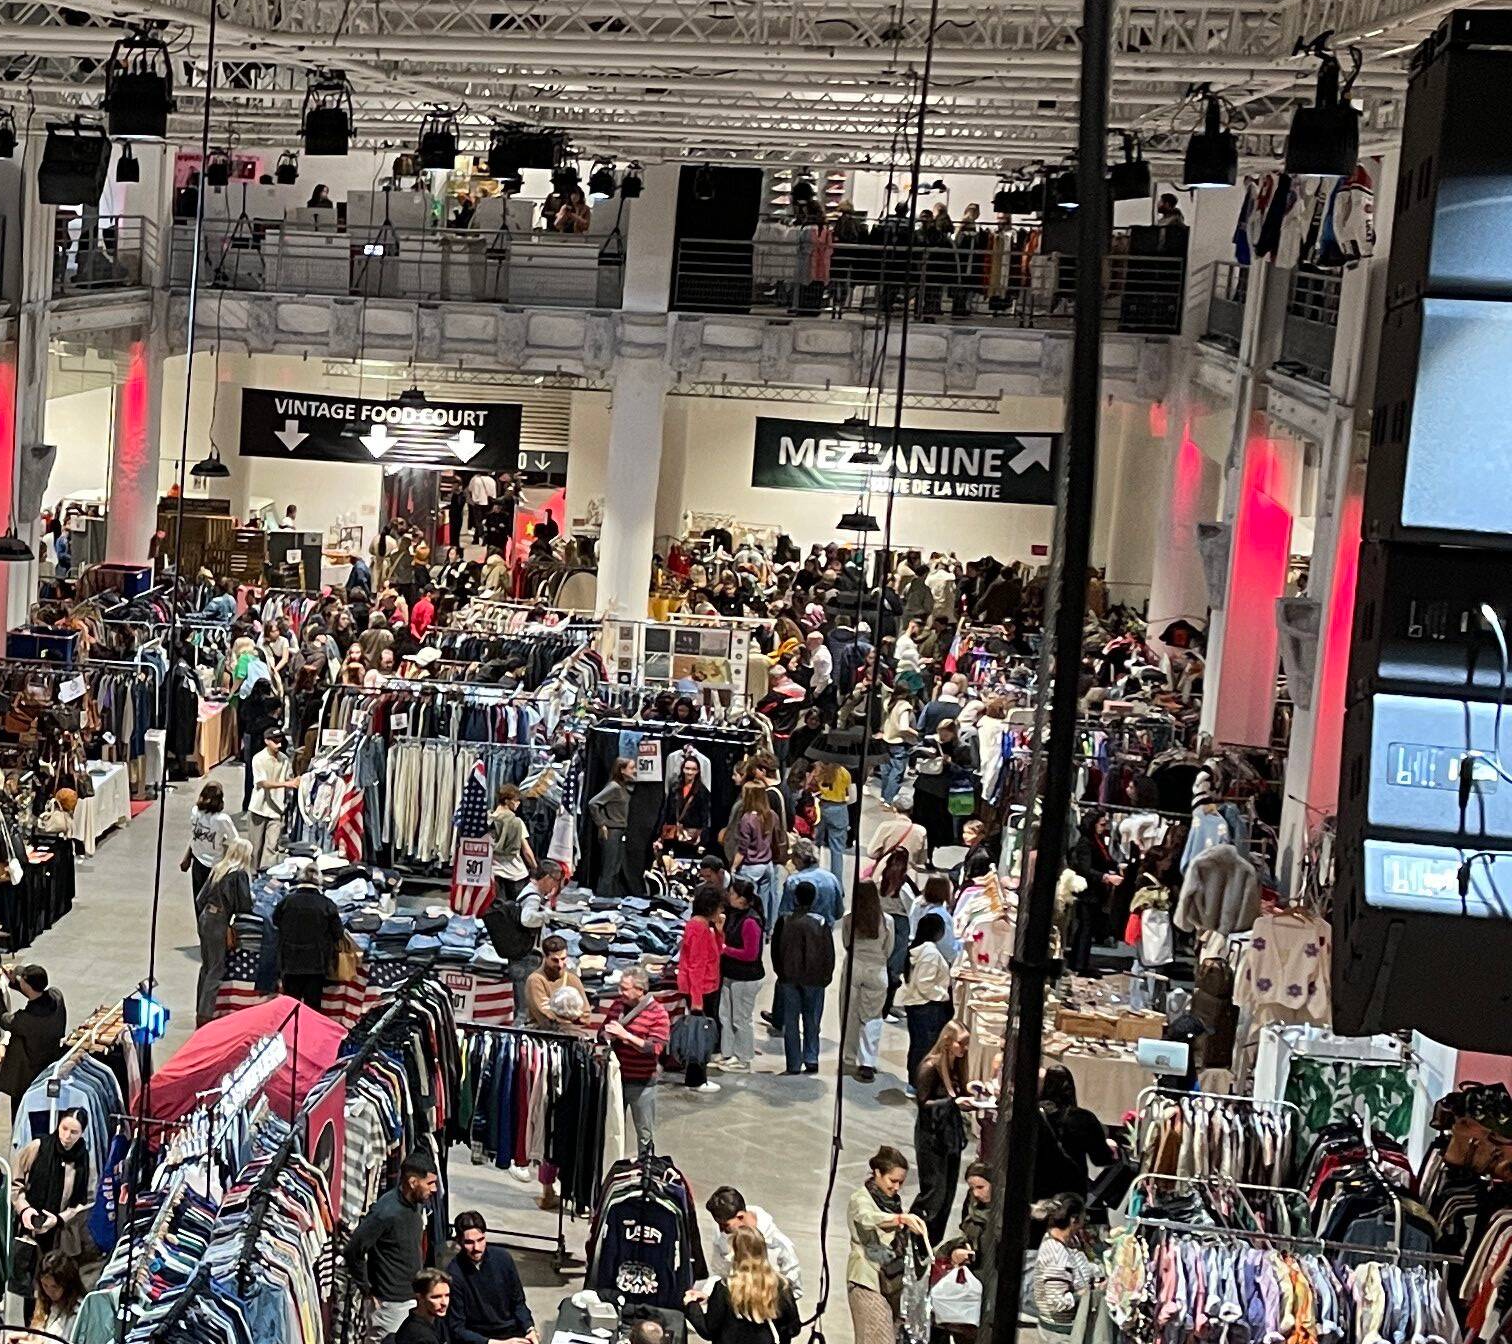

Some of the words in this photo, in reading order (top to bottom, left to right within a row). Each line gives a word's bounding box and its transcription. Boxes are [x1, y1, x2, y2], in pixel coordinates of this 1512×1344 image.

[274, 398, 356, 420] VINTAGE
[361, 404, 415, 425] FOOD
[417, 407, 488, 427] COURT
[911, 478, 932, 495] DE
[933, 480, 952, 496] LA
[955, 482, 1001, 499] VISITE
[466, 859, 484, 875] 501
